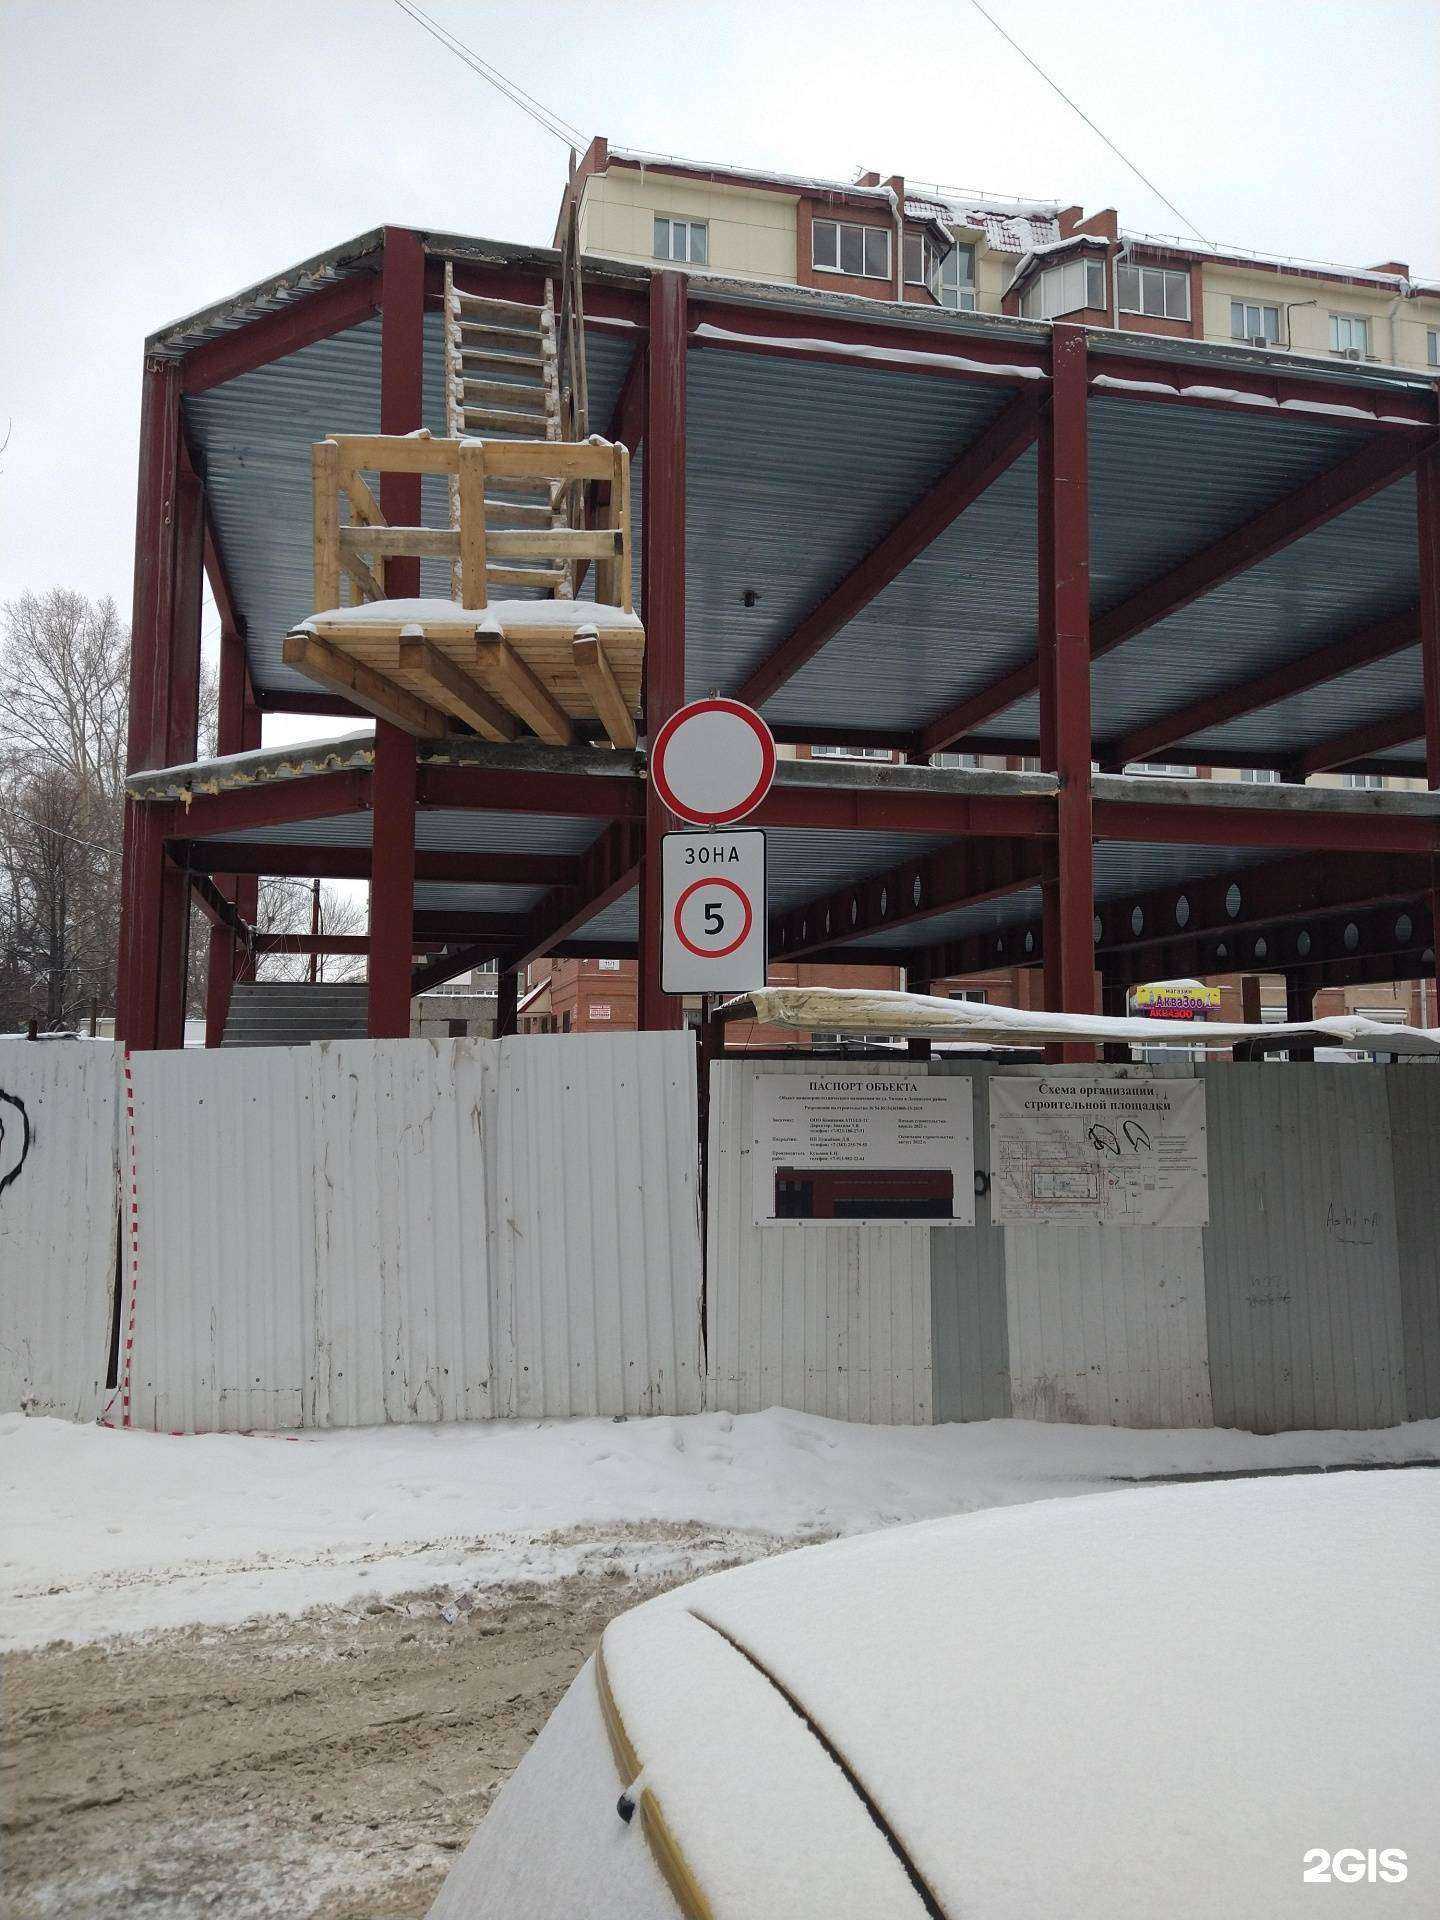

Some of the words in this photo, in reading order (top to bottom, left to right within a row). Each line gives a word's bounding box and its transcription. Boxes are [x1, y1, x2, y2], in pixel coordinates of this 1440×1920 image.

[685, 846, 739, 864] ЗОНА
[704, 902, 725, 935] 5
[809, 1082, 862, 1091] ПАСПОРТ
[866, 1082, 918, 1092] ОБЪЕКТА
[1038, 1083, 1076, 1095] Схема
[1024, 1099, 1108, 1112] строительной
[1110, 1101, 1171, 1113] площадки
